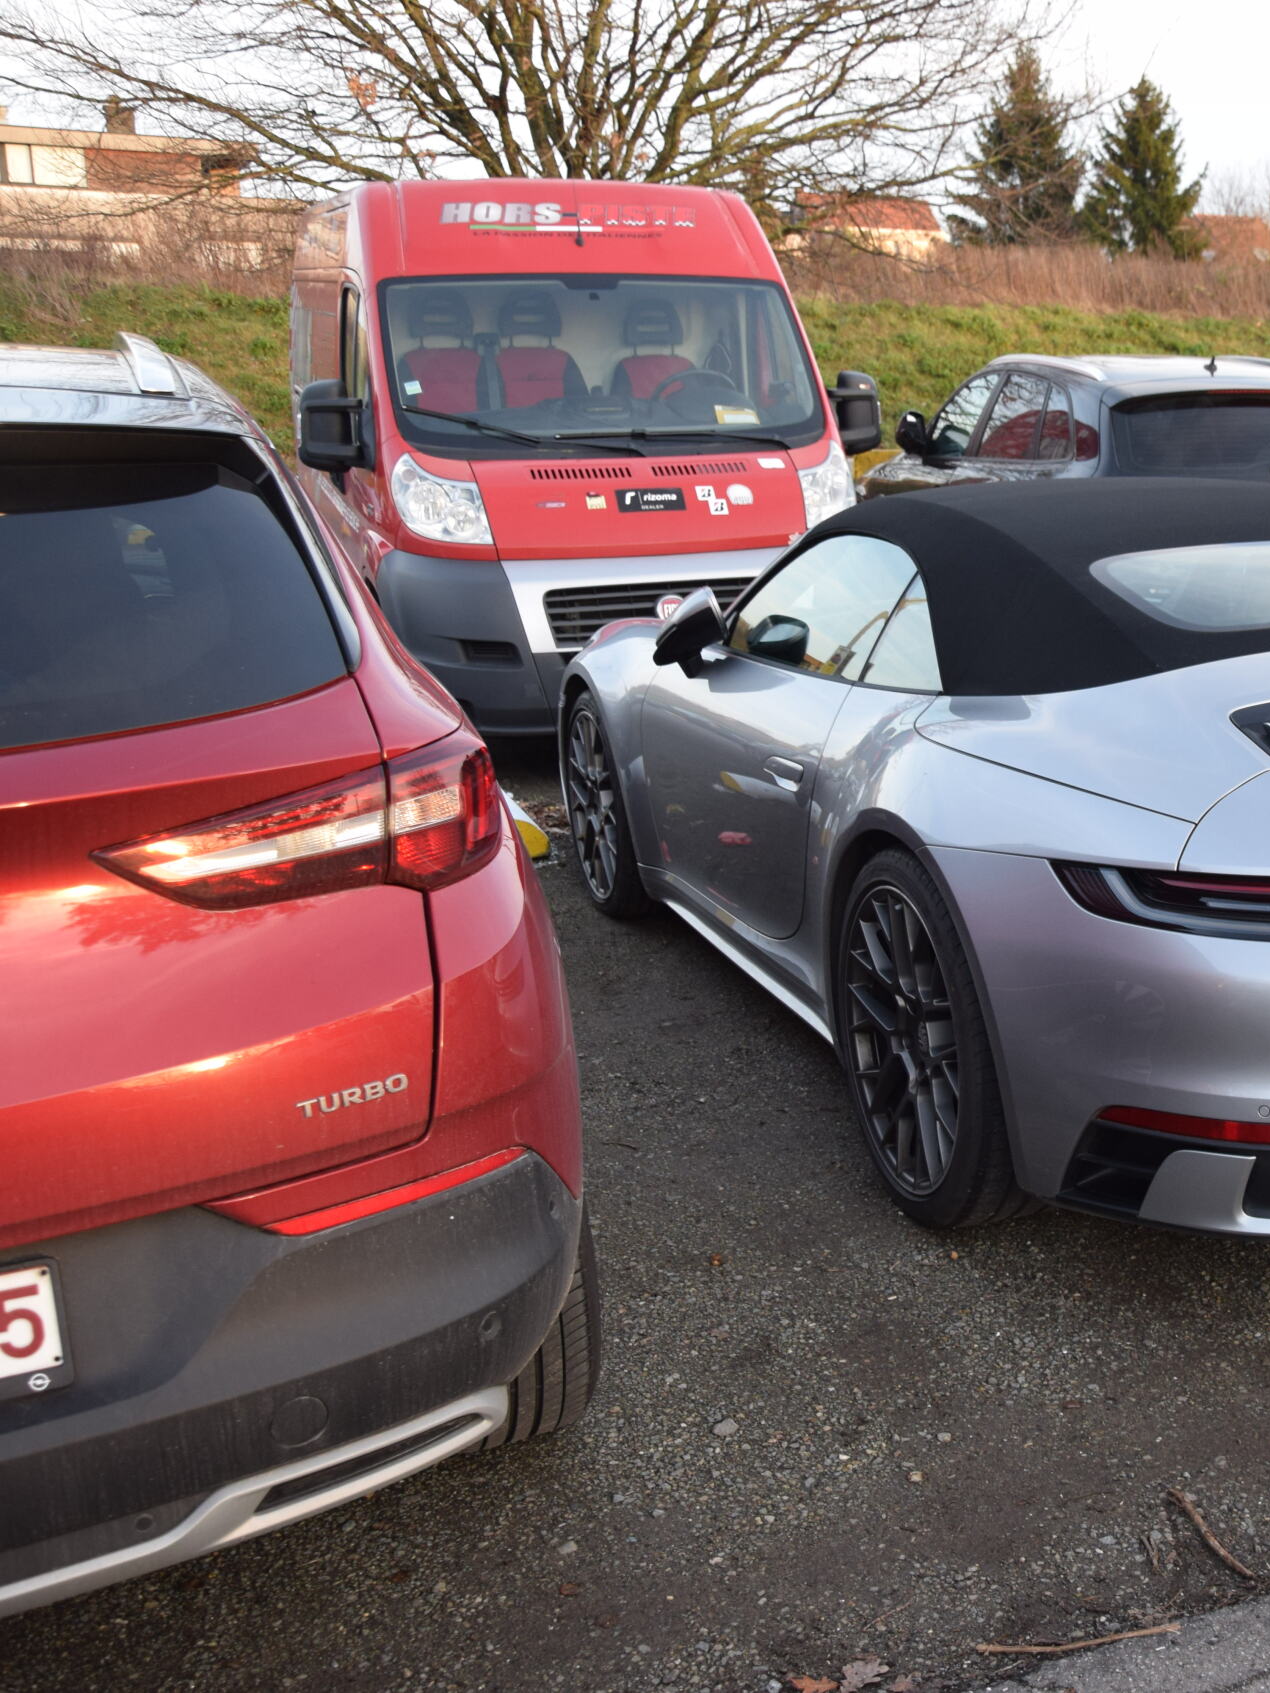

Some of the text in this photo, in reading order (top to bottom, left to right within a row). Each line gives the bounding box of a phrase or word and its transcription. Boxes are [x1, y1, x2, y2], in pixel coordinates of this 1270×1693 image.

[439, 201, 696, 227] HORS-PISTE
[643, 492, 677, 502] rizoma
[296, 1073, 409, 1118] TURBO
